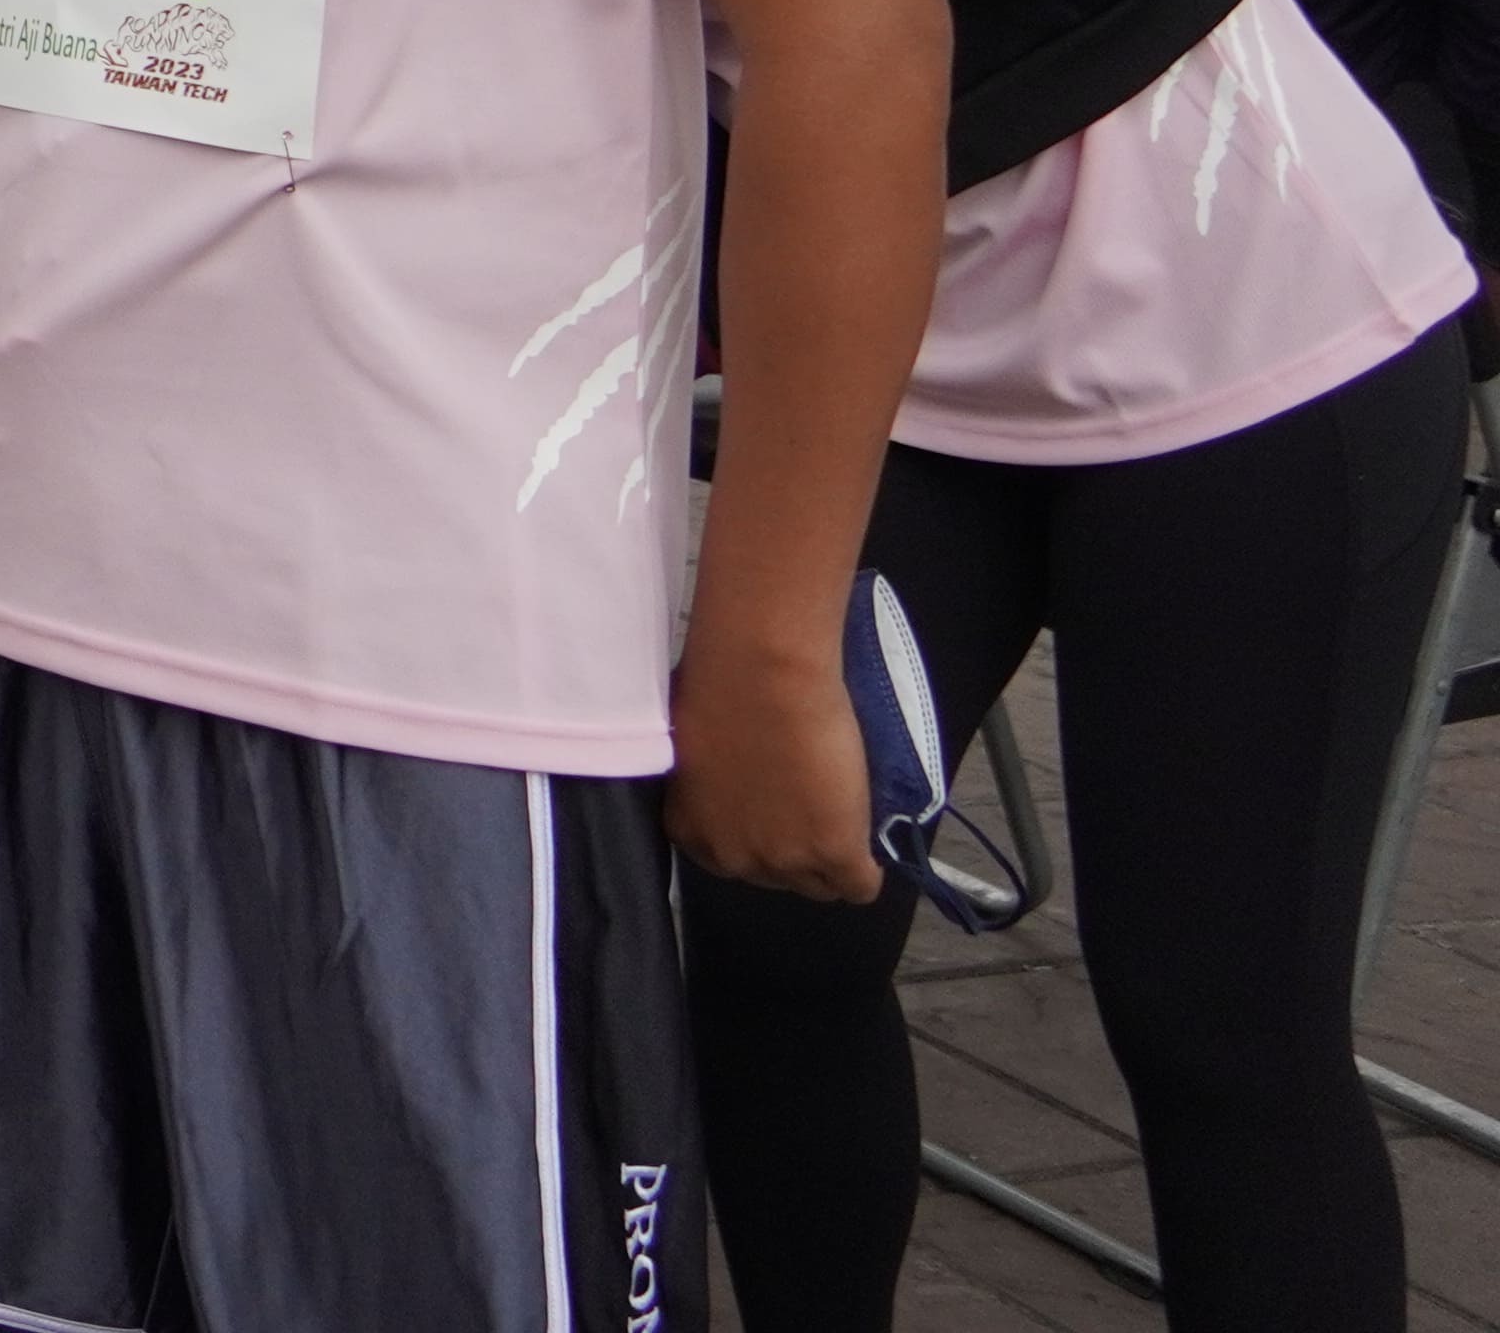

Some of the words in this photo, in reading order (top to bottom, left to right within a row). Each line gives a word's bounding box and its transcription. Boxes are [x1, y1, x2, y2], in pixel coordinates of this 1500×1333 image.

[16, 17, 41, 62] Aji
[42, 22, 98, 62] Buana
[102, 67, 178, 95] TAIWAN
[182, 81, 228, 104] TECH
[142, 56, 205, 81] 2023
